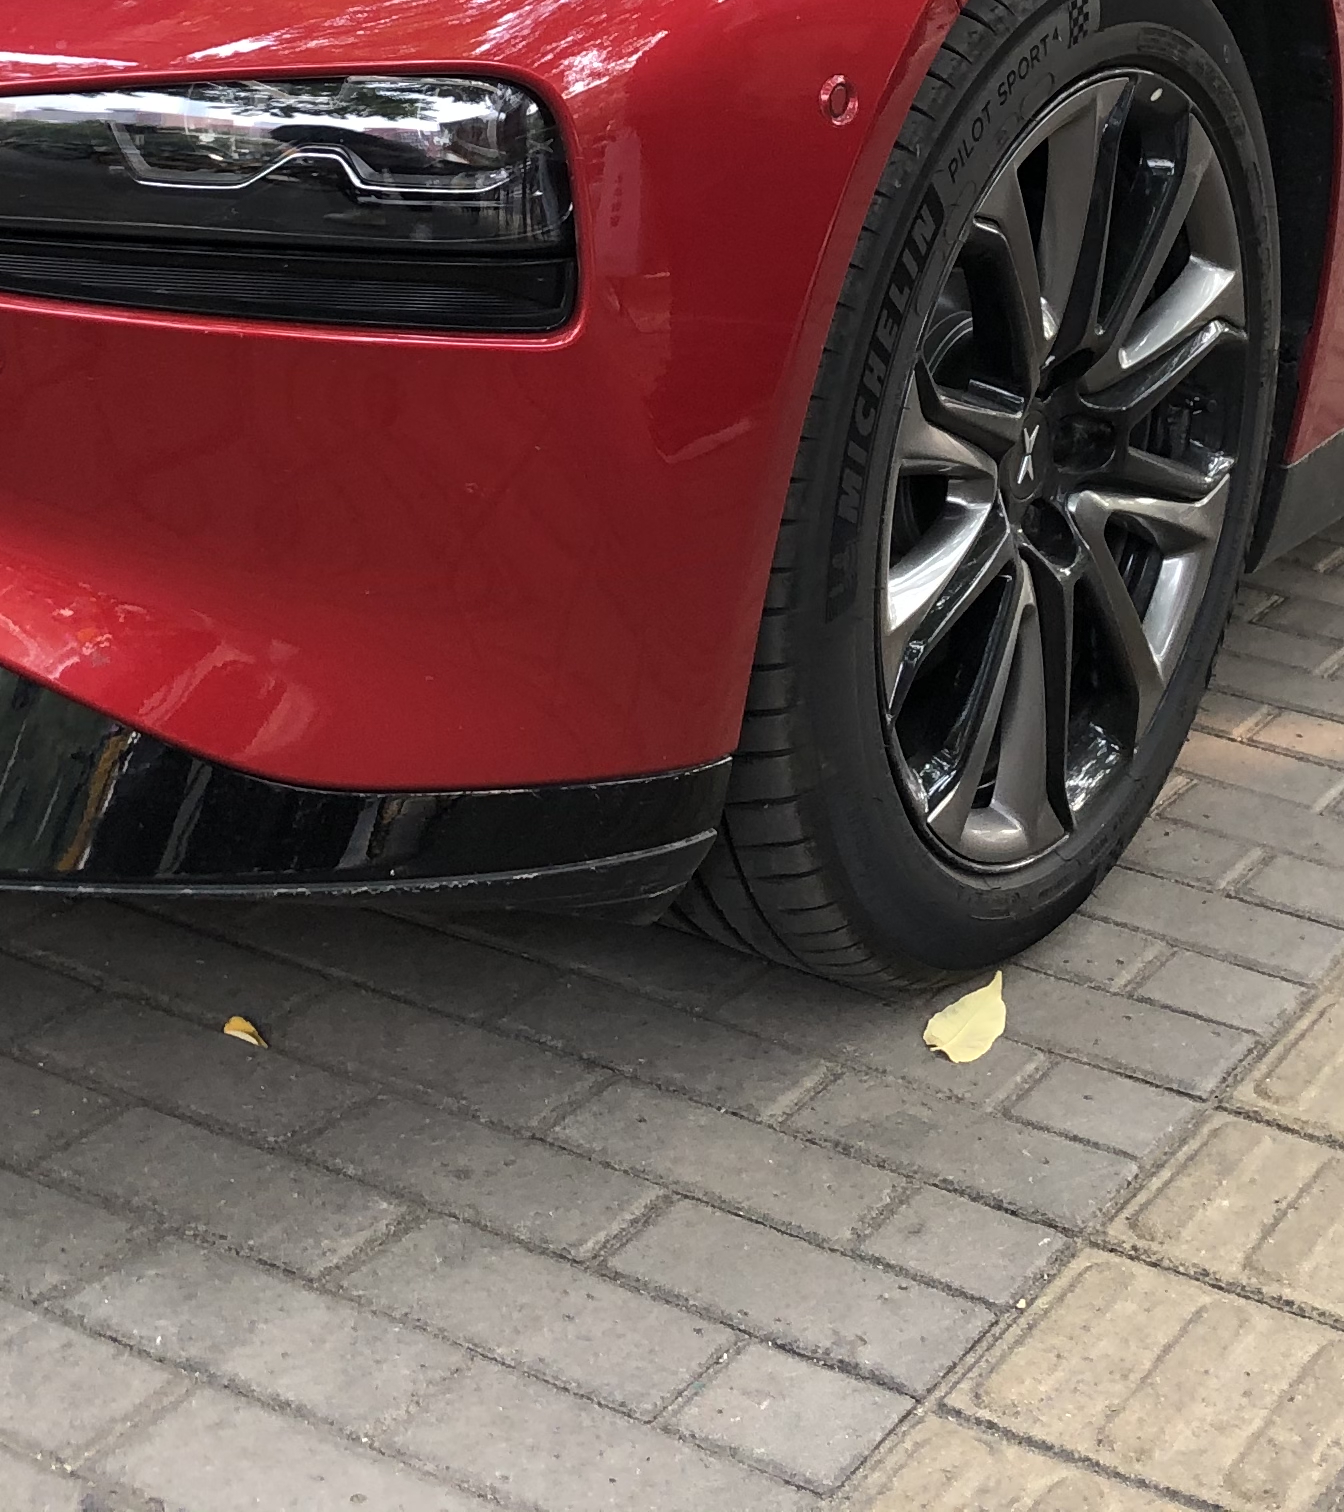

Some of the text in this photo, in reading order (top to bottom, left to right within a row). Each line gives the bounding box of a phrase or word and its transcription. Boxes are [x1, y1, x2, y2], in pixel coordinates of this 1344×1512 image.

[947, 100, 993, 184] PILOT
[997, 34, 1050, 107] SPORT
[837, 202, 938, 525] MICHELIN
